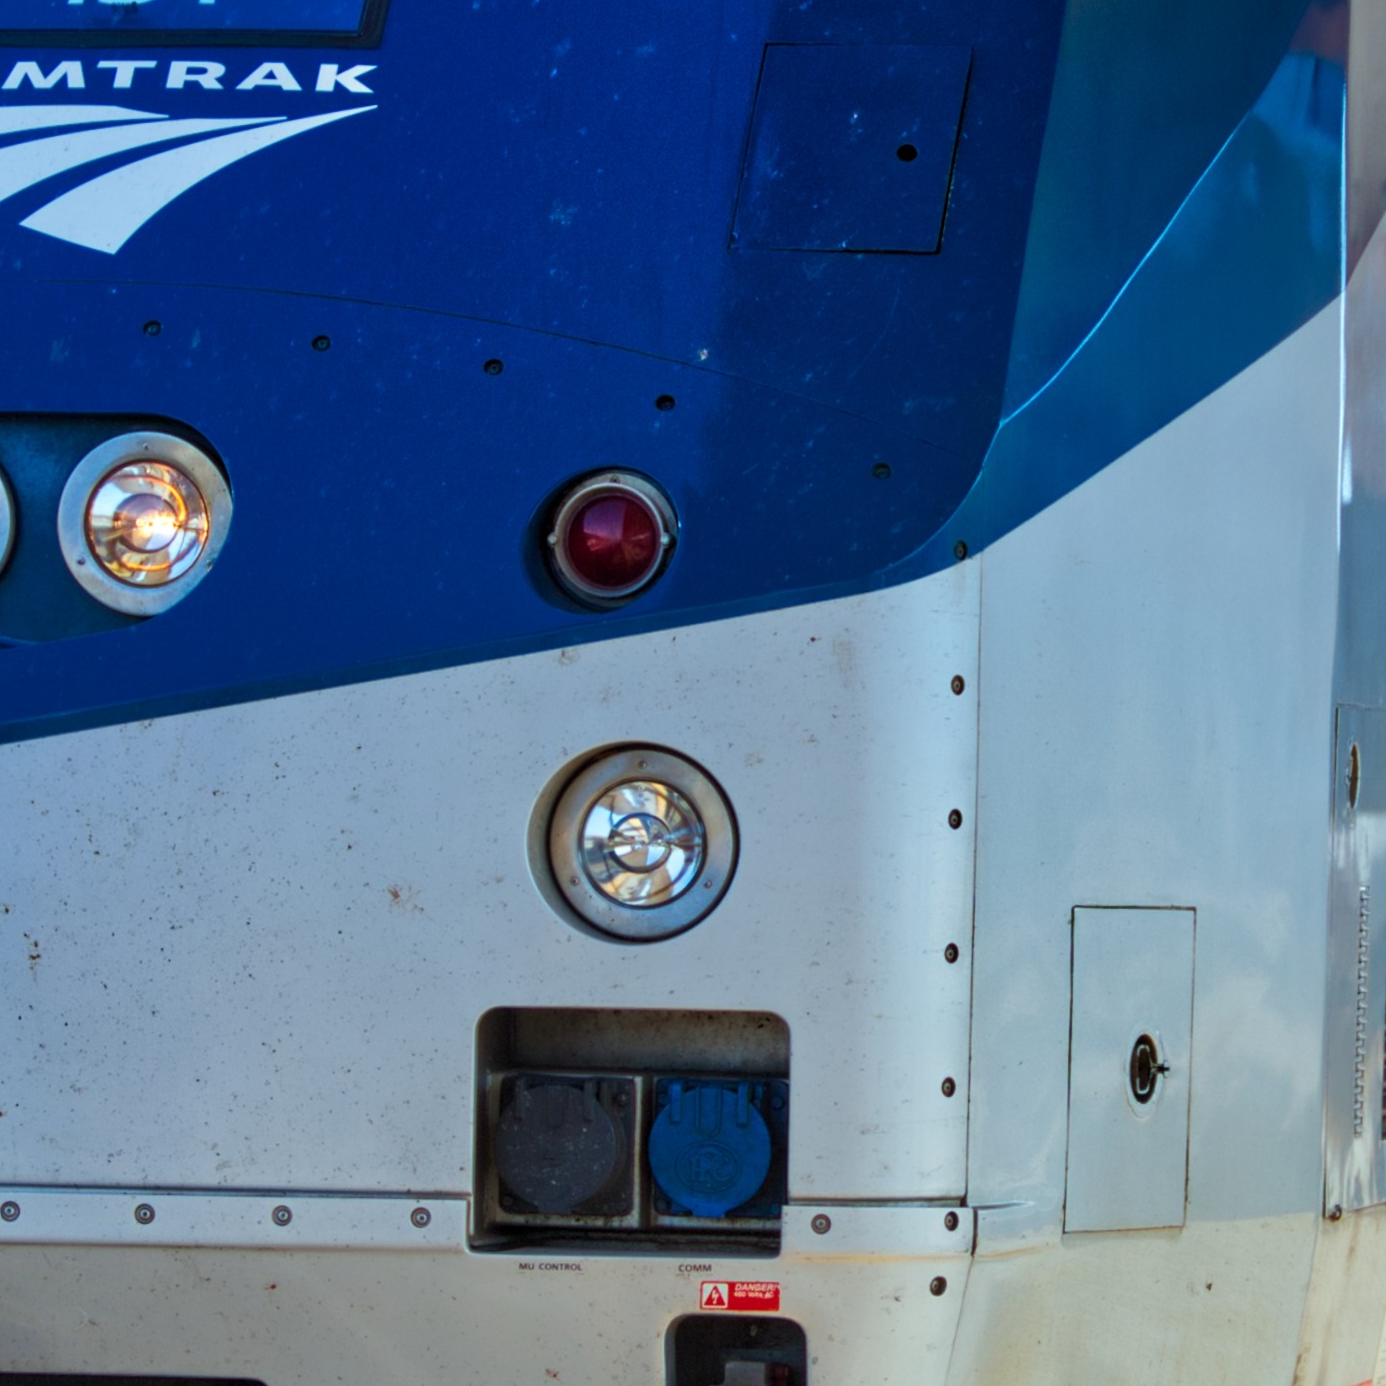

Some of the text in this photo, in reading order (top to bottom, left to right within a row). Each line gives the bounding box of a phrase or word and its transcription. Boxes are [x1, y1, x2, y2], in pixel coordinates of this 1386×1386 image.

[518, 1262, 582, 1271] MU CONTROL
[678, 1264, 712, 1273] COMM
